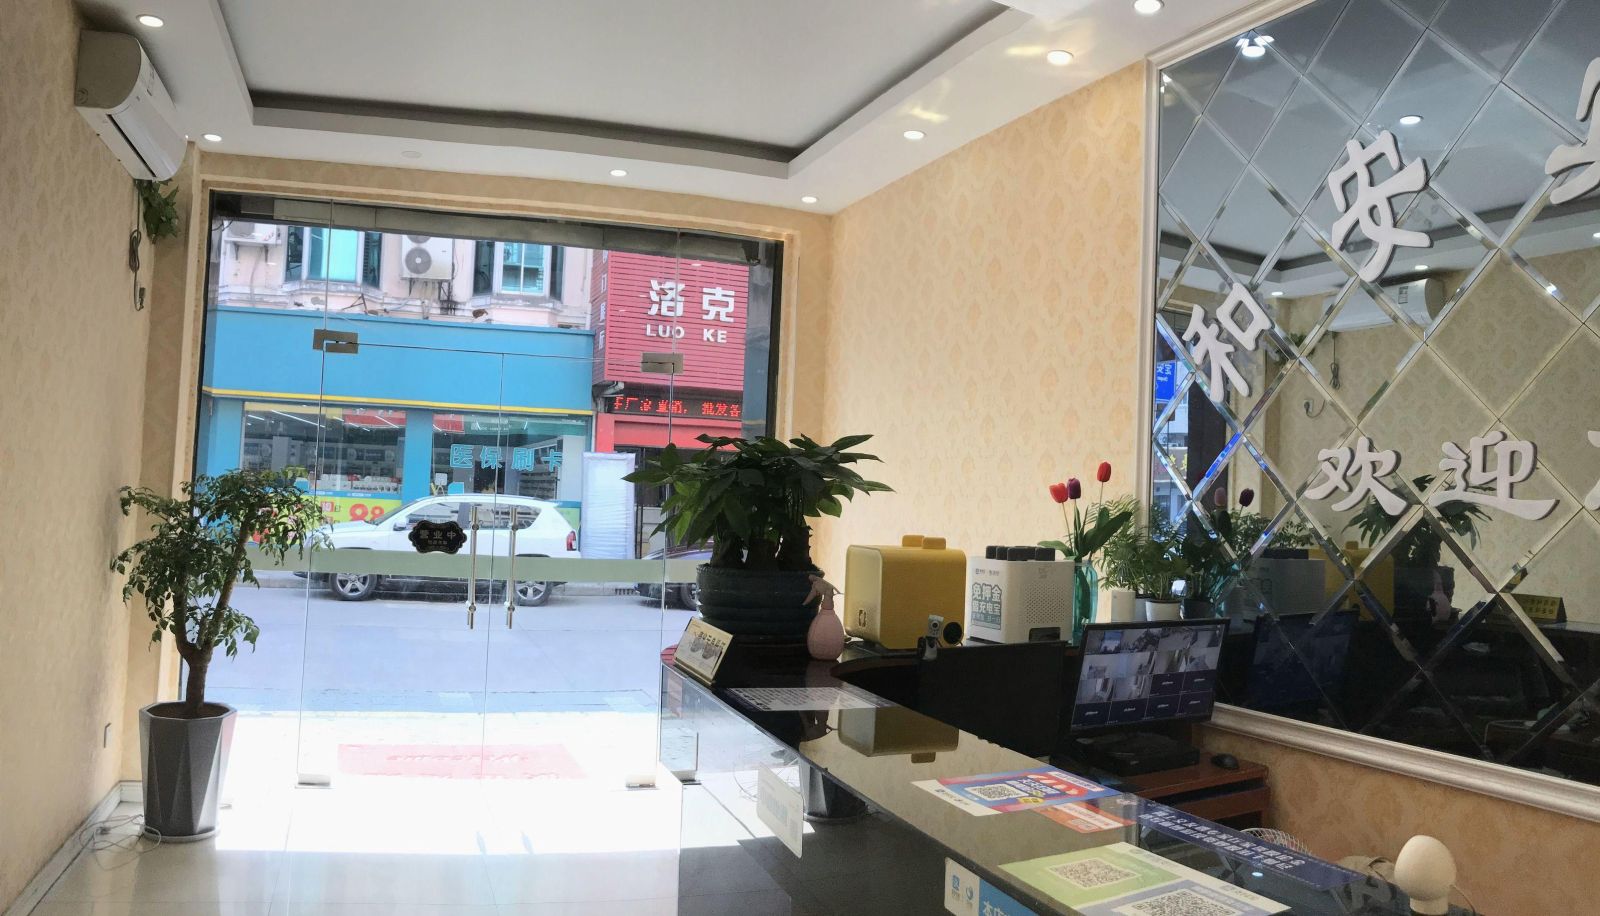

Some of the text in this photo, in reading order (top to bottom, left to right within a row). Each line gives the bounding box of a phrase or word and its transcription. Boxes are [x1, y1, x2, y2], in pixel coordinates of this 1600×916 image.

[648, 279, 735, 323] 洛克
[646, 324, 728, 343] LUO KE
[449, 443, 563, 473] 医保刷卡
[1303, 429, 1600, 521] 欢迎
[419, 529, 457, 541] 营业中
[971, 582, 1002, 602] 免押金
